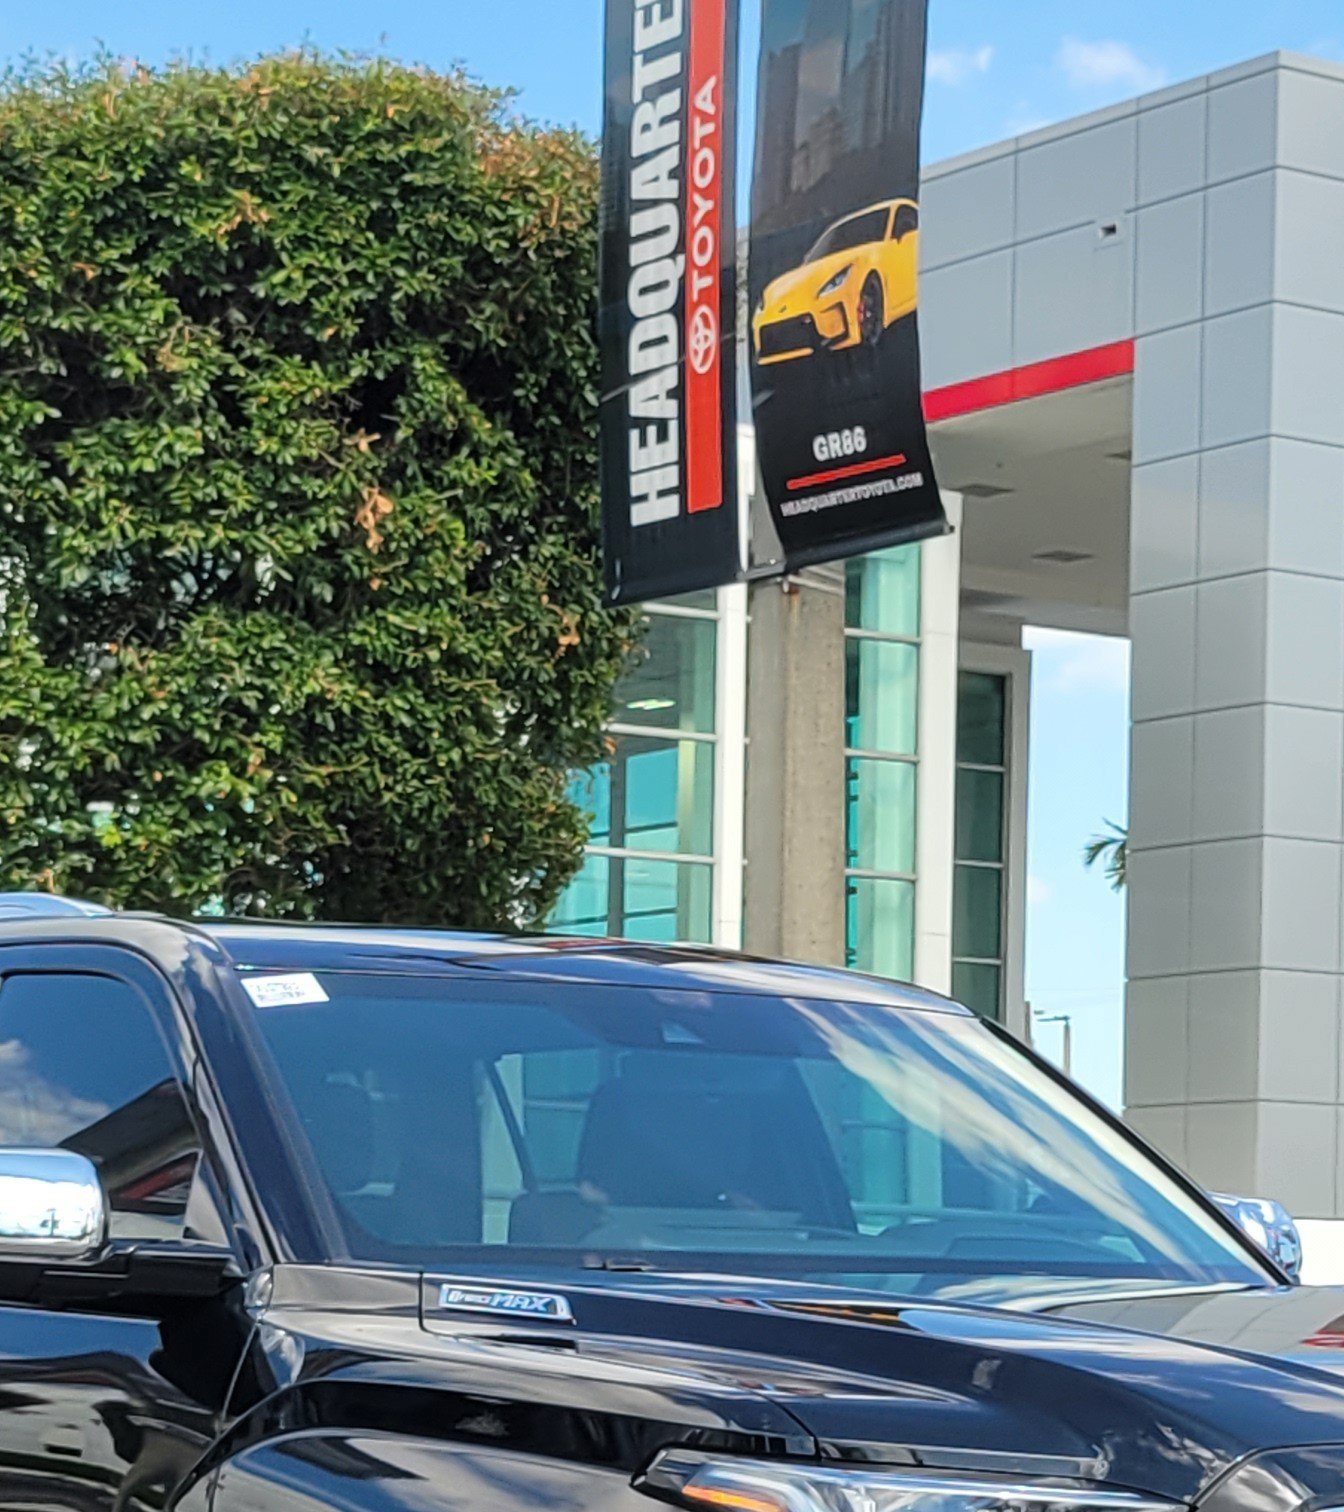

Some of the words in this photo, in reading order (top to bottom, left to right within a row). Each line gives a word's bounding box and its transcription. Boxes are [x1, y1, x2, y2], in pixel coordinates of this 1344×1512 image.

[692, 75, 717, 302] TOYOTA
[628, 0, 685, 527] HEADQUARTE
[812, 425, 867, 462] GR86
[490, 1293, 551, 1311] MAX
